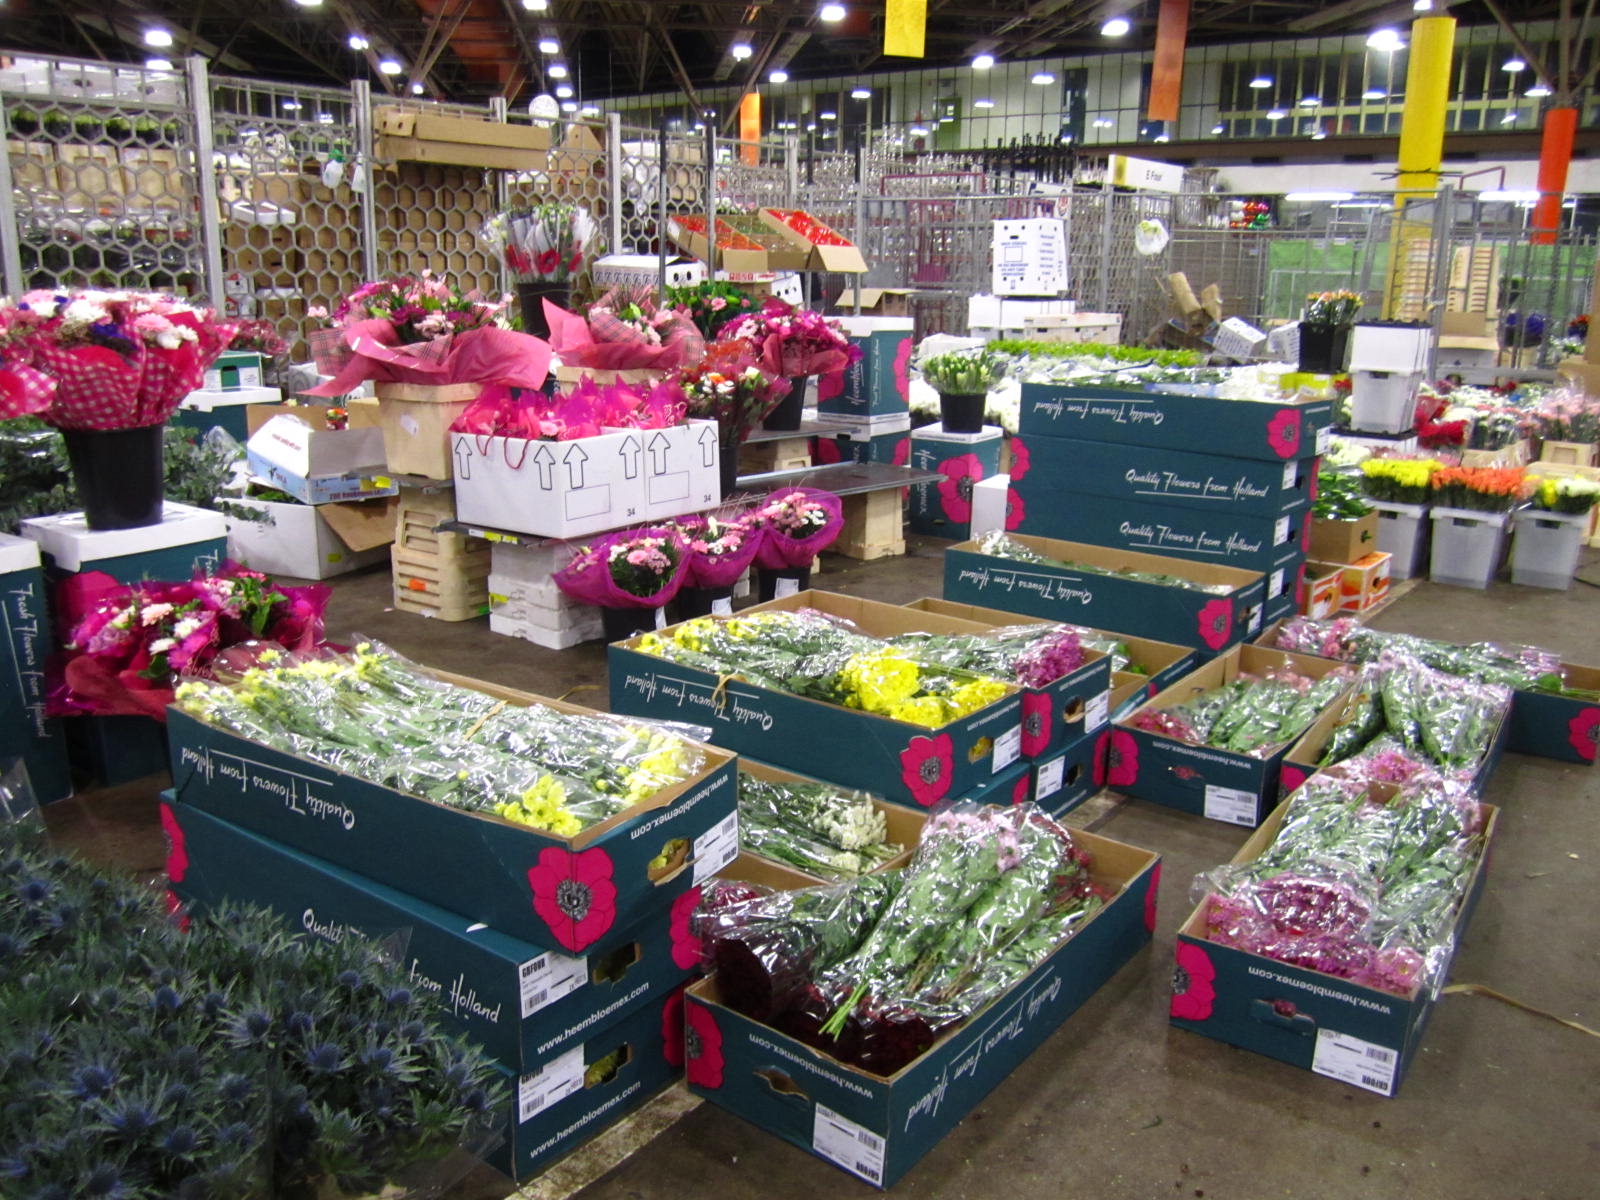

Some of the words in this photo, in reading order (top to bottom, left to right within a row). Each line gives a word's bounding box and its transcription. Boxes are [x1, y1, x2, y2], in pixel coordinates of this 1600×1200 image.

[1033, 397, 1063, 420] Holland
[1067, 400, 1089, 419] from
[1092, 402, 1127, 424] Flowers
[1129, 403, 1164, 425] Quality
[1125, 468, 1160, 491] Quality
[1163, 471, 1200, 491] Flowers
[1202, 476, 1228, 496] from
[1233, 476, 1269, 501] Holland
[1120, 521, 1154, 543] Quality
[1156, 525, 1194, 545] Flowers
[1195, 531, 1221, 550] from
[1226, 531, 1262, 556] Holland
[959, 567, 989, 590] Holland
[993, 572, 1016, 592] from
[1018, 579, 1054, 600] Flowers
[1057, 580, 1092, 605] Quality
[7, 583, 35, 620] Fresh
[13, 620, 38, 666] Flowers
[20, 670, 45, 696] from
[624, 672, 657, 703] Holland
[662, 681, 685, 707] from
[732, 697, 773, 731] Quality
[181, 746, 215, 785] Holland
[220, 759, 248, 792] from
[252, 776, 306, 815] Flowers
[305, 783, 355, 830] Quality
[631, 774, 729, 840] www.heembloemex.com
[302, 908, 344, 944] Qualit
[409, 958, 442, 992] from
[450, 973, 501, 1024] Holland
[1027, 976, 1062, 1021] Quality
[1248, 965, 1391, 1015] www.heembloemex.com
[537, 981, 650, 1055] www.heembloemex.com
[985, 1001, 1024, 1053] Flowers
[749, 1033, 873, 1099] www.heembloemex.com
[904, 1065, 948, 1133] Holland
[530, 1080, 641, 1159] www.heembloemex.com
